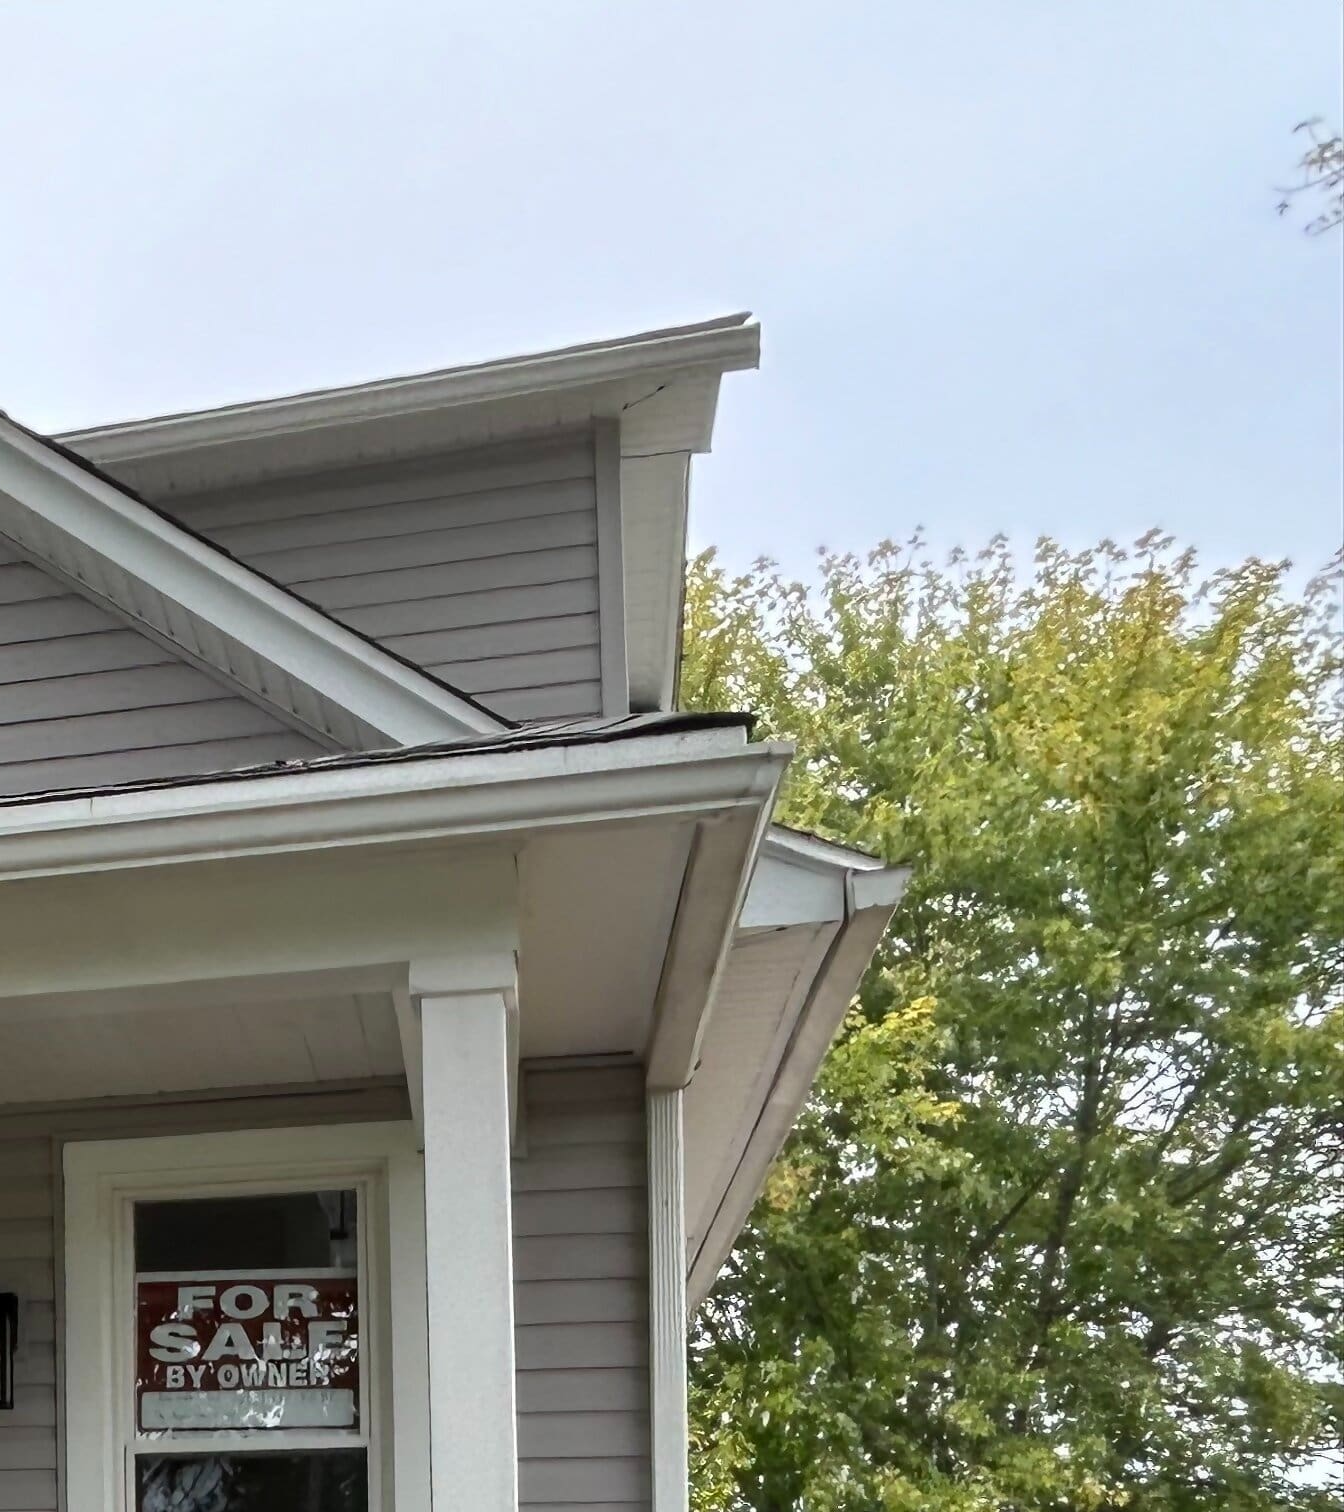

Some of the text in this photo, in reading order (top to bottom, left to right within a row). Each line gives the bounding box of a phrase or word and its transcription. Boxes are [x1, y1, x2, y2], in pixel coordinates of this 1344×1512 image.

[177, 1284, 322, 1320] FOR
[148, 1321, 348, 1362] SALE
[166, 1362, 330, 1388] BY OWNER
